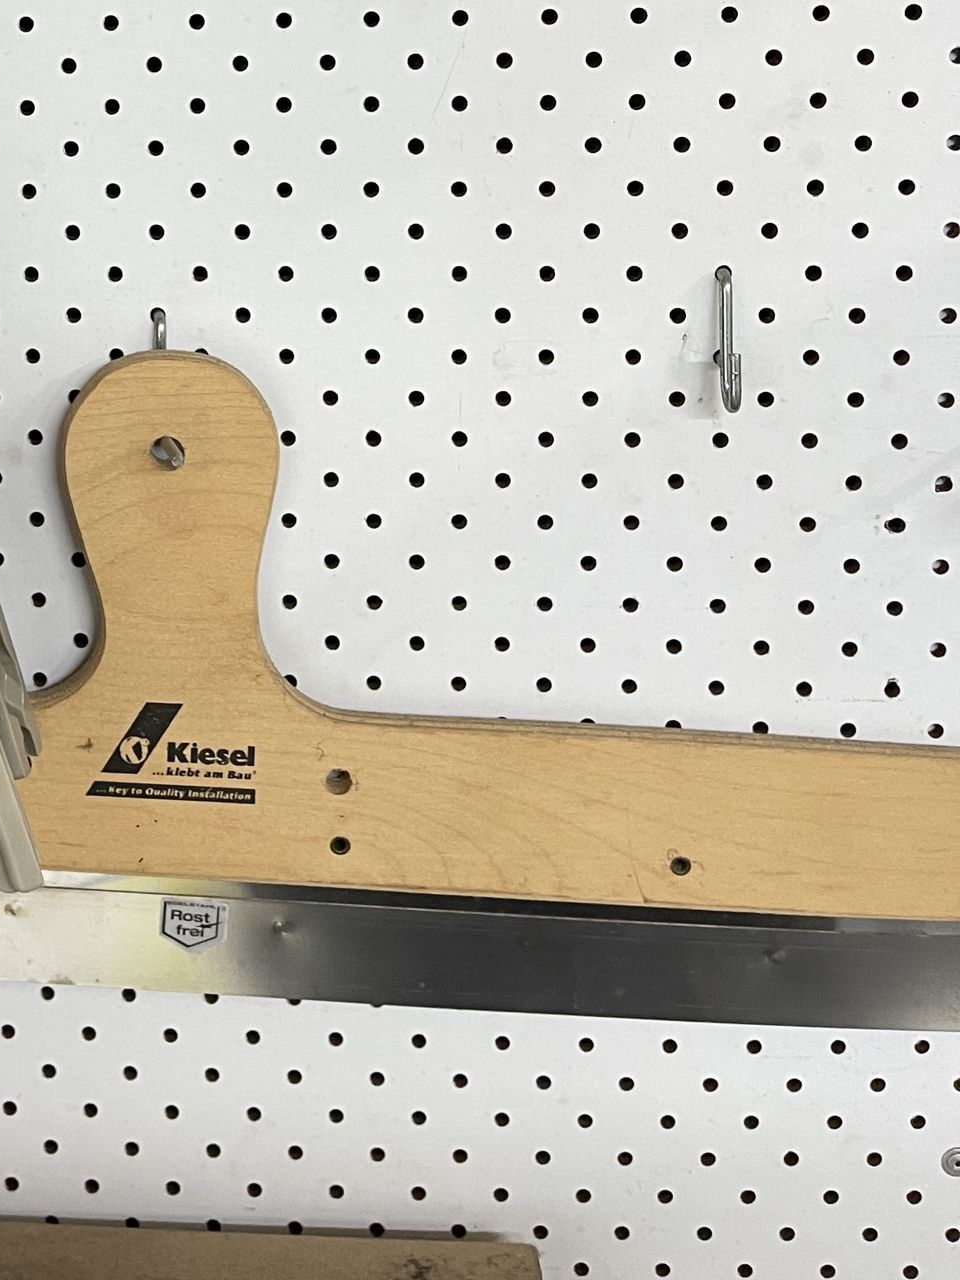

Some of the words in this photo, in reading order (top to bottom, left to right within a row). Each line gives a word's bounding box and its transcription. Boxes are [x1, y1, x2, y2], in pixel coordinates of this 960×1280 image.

[167, 742, 256, 766] Kiesel
[204, 771, 223, 779] am
[131, 787, 142, 795] to
[145, 787, 185, 799] Quality
[188, 788, 251, 801] Installation
[171, 909, 210, 923] Rost
[176, 924, 205, 937] frei
